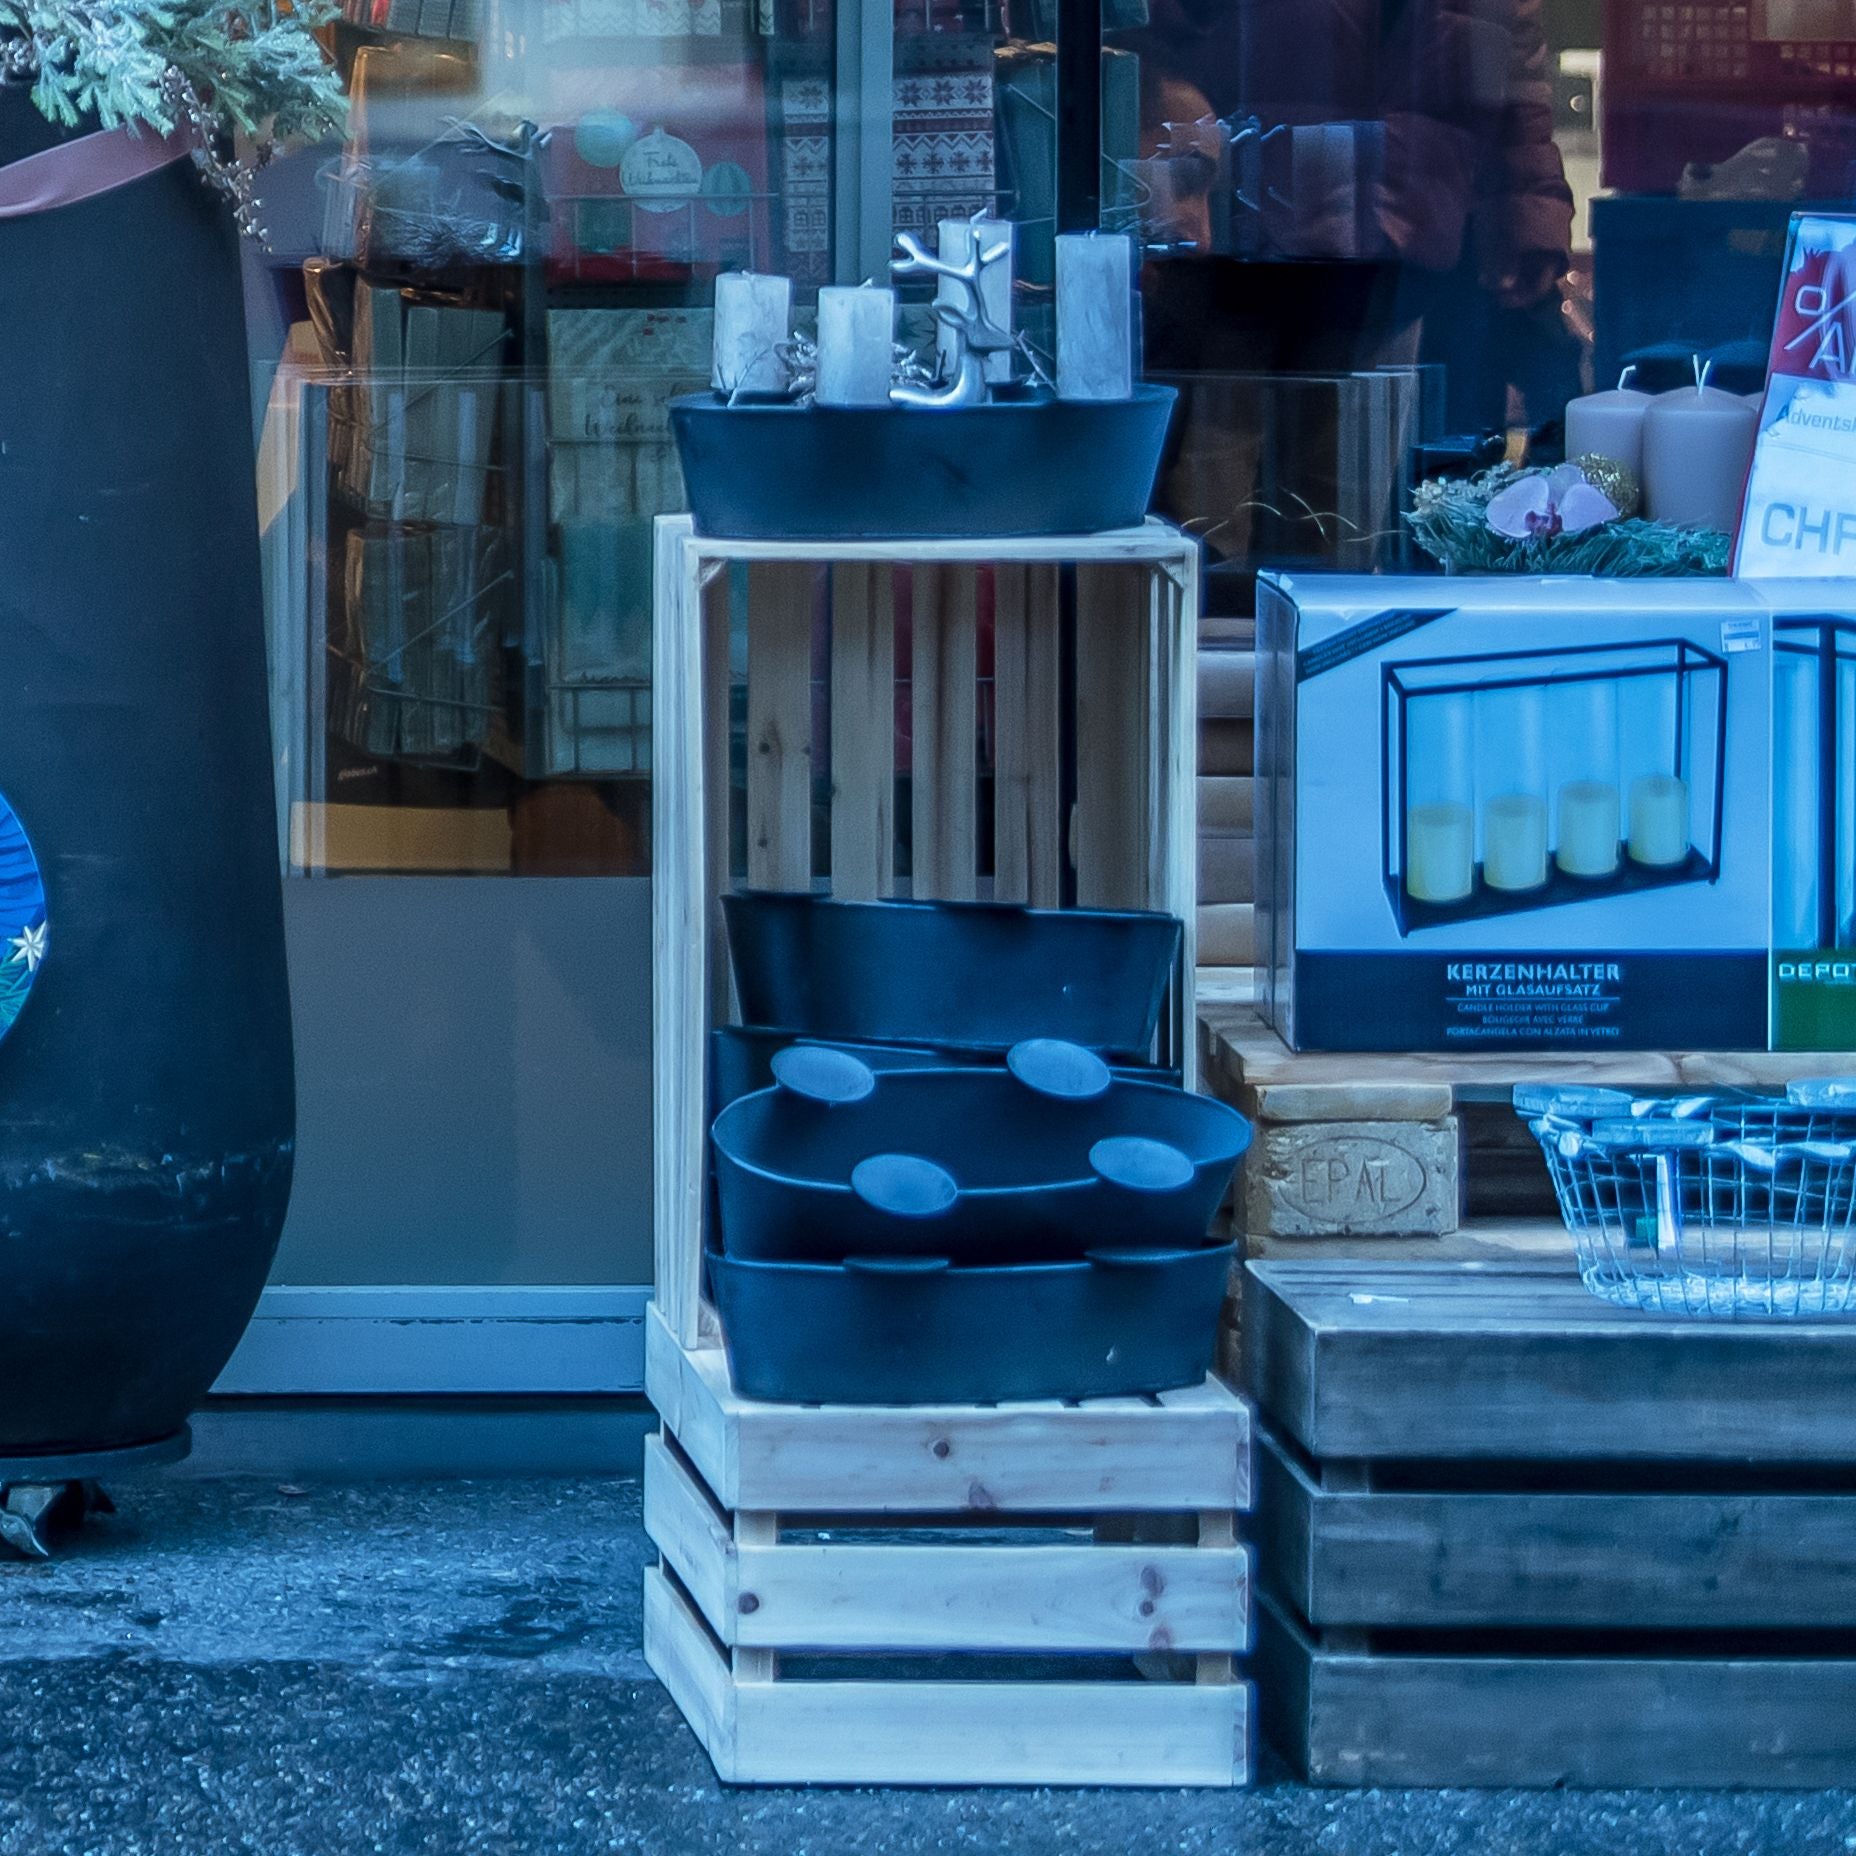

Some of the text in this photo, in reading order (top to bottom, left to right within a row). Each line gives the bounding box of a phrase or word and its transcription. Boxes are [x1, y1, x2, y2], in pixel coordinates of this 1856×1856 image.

[1446, 962, 1621, 982] KERZENHALTER
[1466, 984, 1601, 997] MIT GLASAUFSATZ
[1300, 1157, 1402, 1205] EPAL
